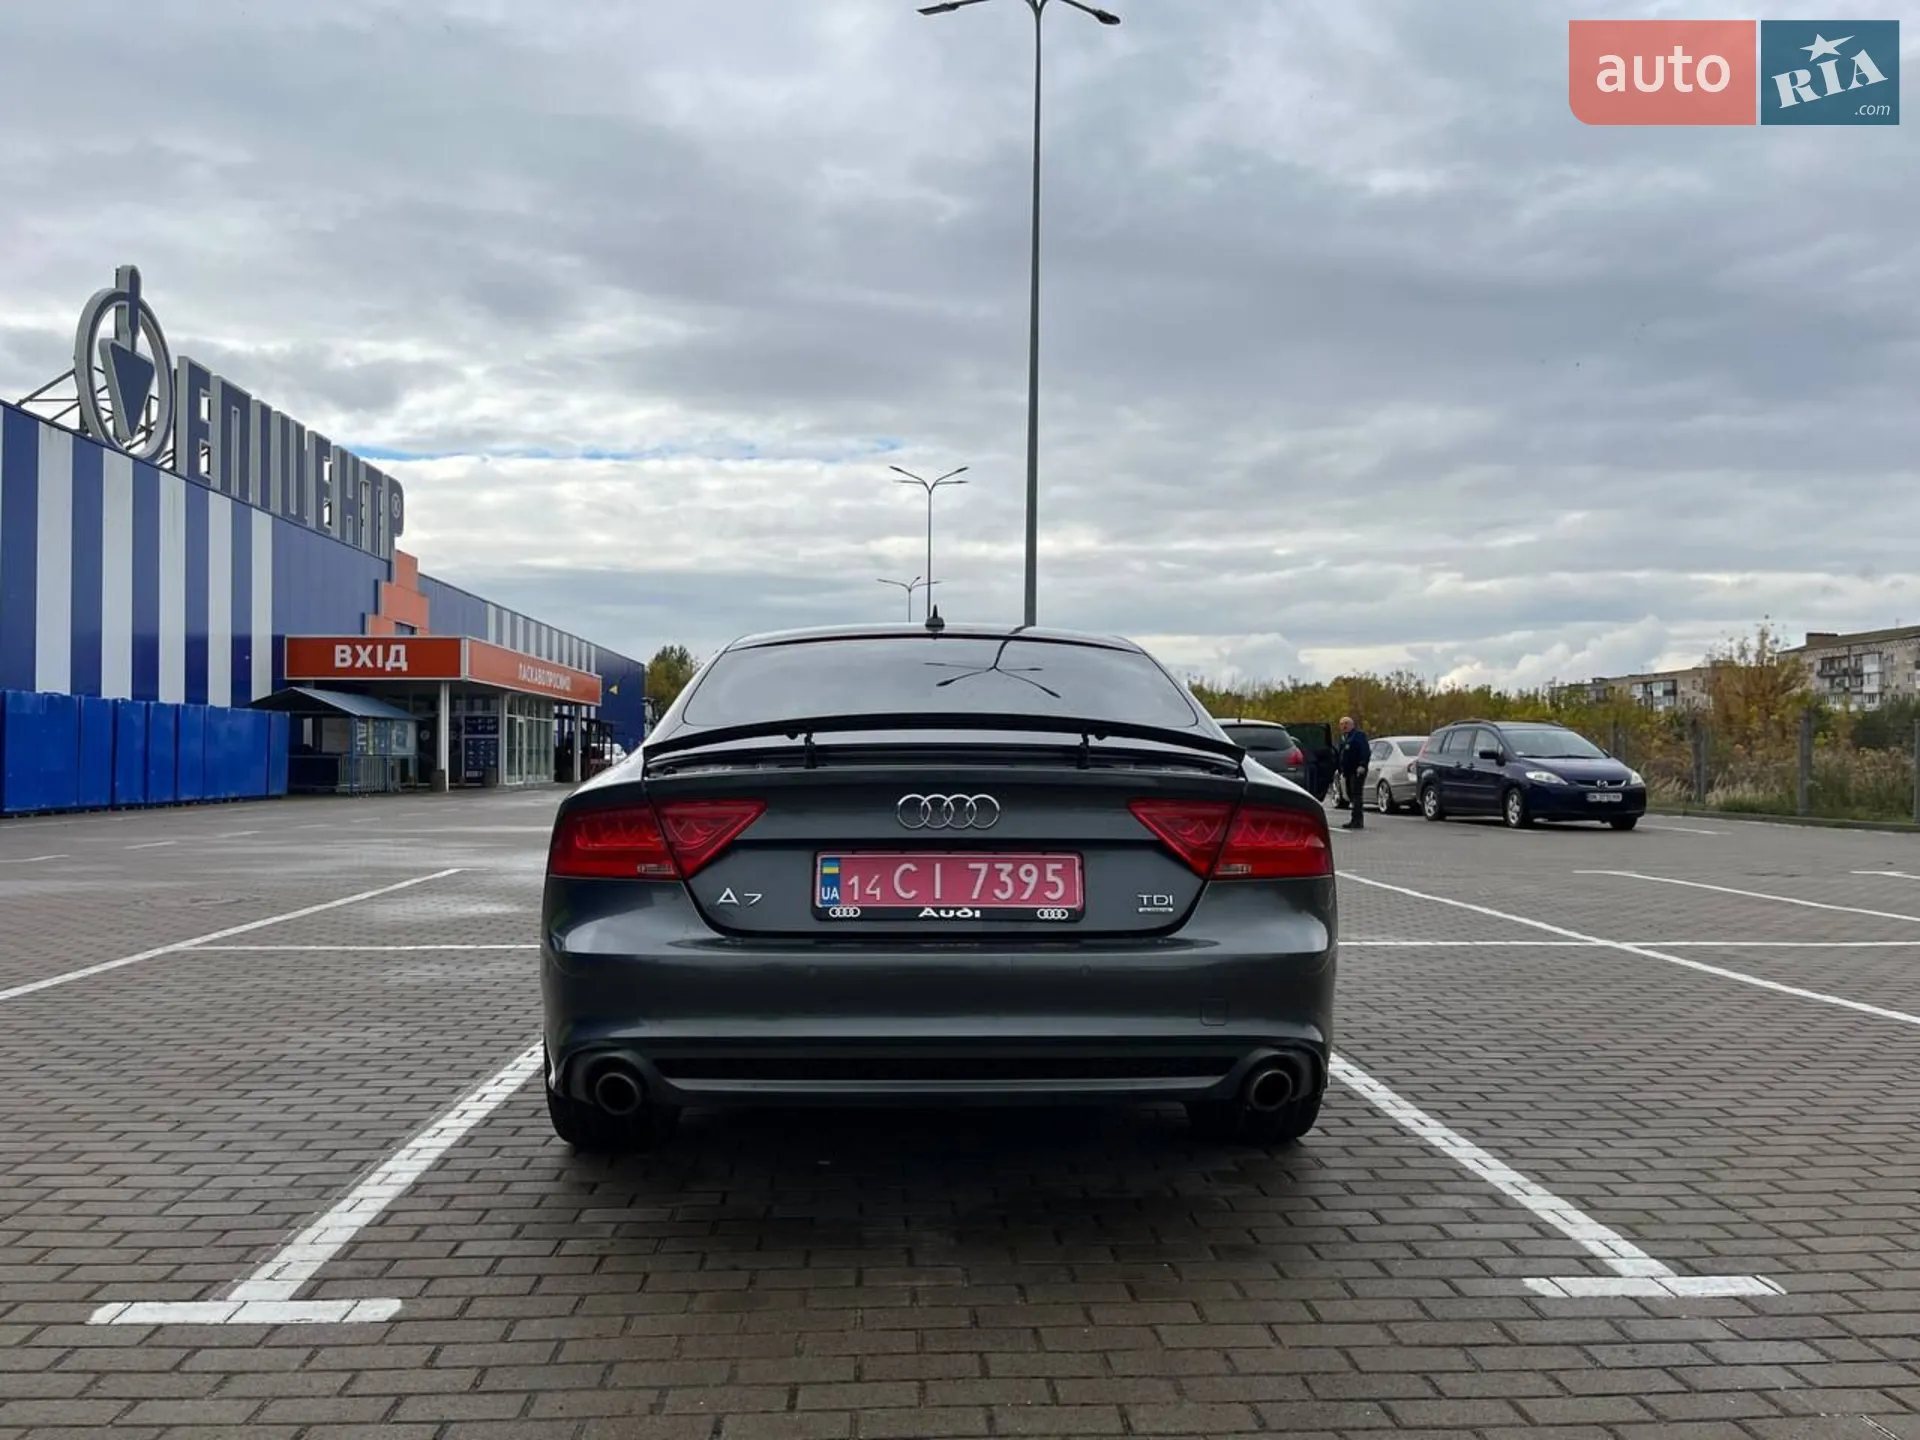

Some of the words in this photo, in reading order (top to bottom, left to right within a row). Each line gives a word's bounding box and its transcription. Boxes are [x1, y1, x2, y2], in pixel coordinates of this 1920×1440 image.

[334, 644, 408, 671] ВХІД
[848, 874, 882, 901] 14
[893, 863, 941, 899] CI
[968, 863, 1065, 900] 7395
[716, 887, 763, 906] A7
[821, 887, 840, 900] UA
[1137, 894, 1173, 906] TDI
[918, 907, 981, 918] Audi
